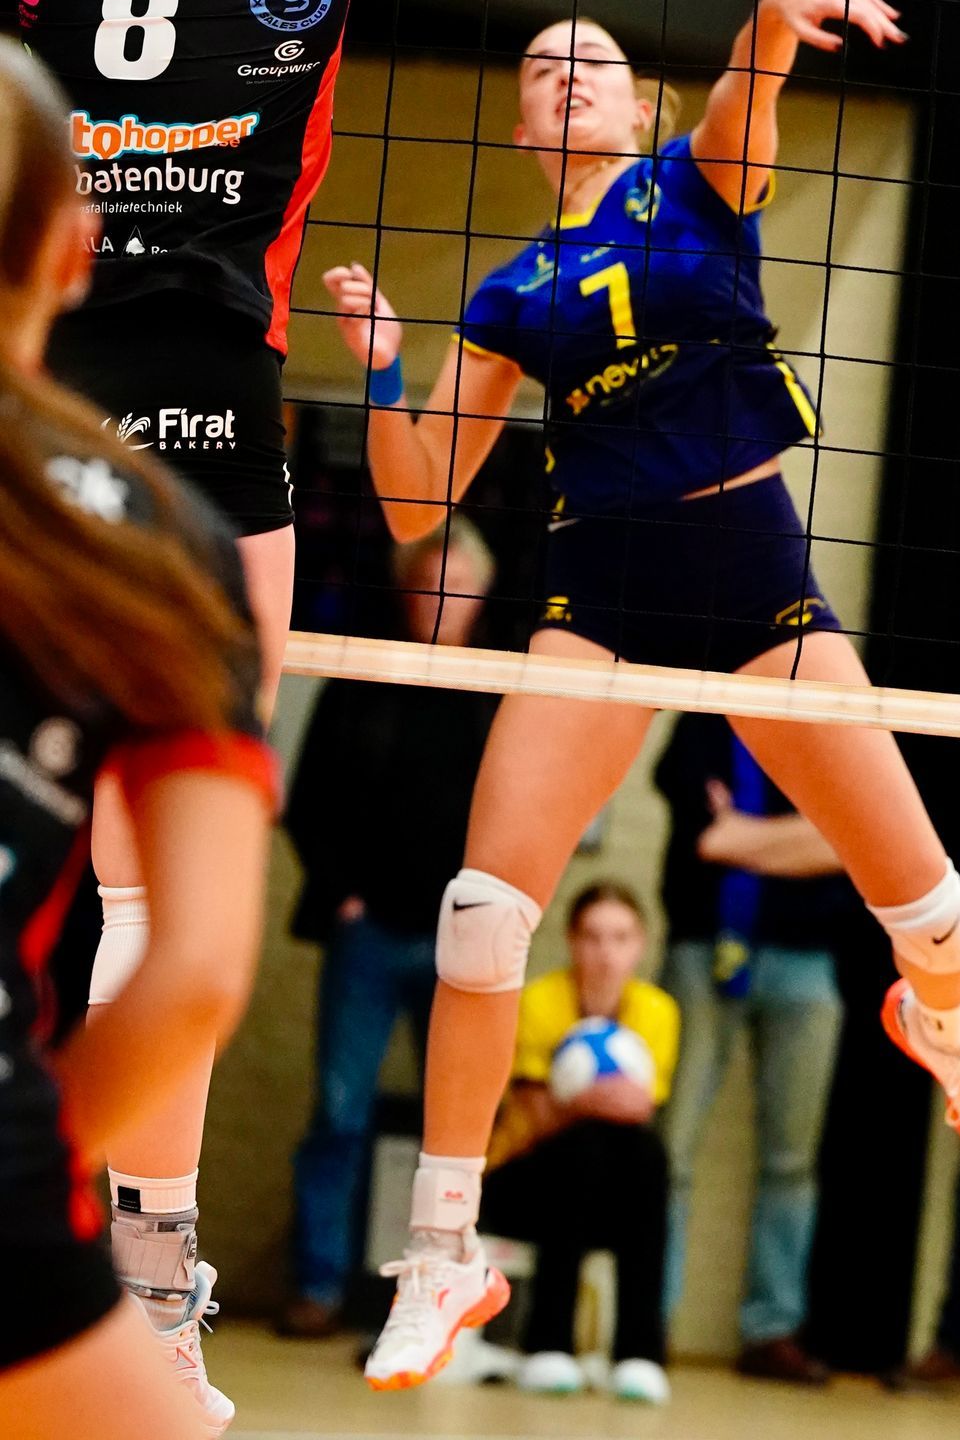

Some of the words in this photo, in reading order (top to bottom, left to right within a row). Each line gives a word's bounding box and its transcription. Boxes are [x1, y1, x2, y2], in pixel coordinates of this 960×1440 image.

[259, 11, 298, 30] SALES
[300, 3, 329, 28] CLUB
[71, 110, 259, 160] tohopper
[75, 158, 245, 205] batenburg
[81, 201, 183, 214] stallatietechniek
[579, 261, 637, 350] 7
[158, 408, 236, 439] Firat
[159, 441, 236, 450] BAKERY
